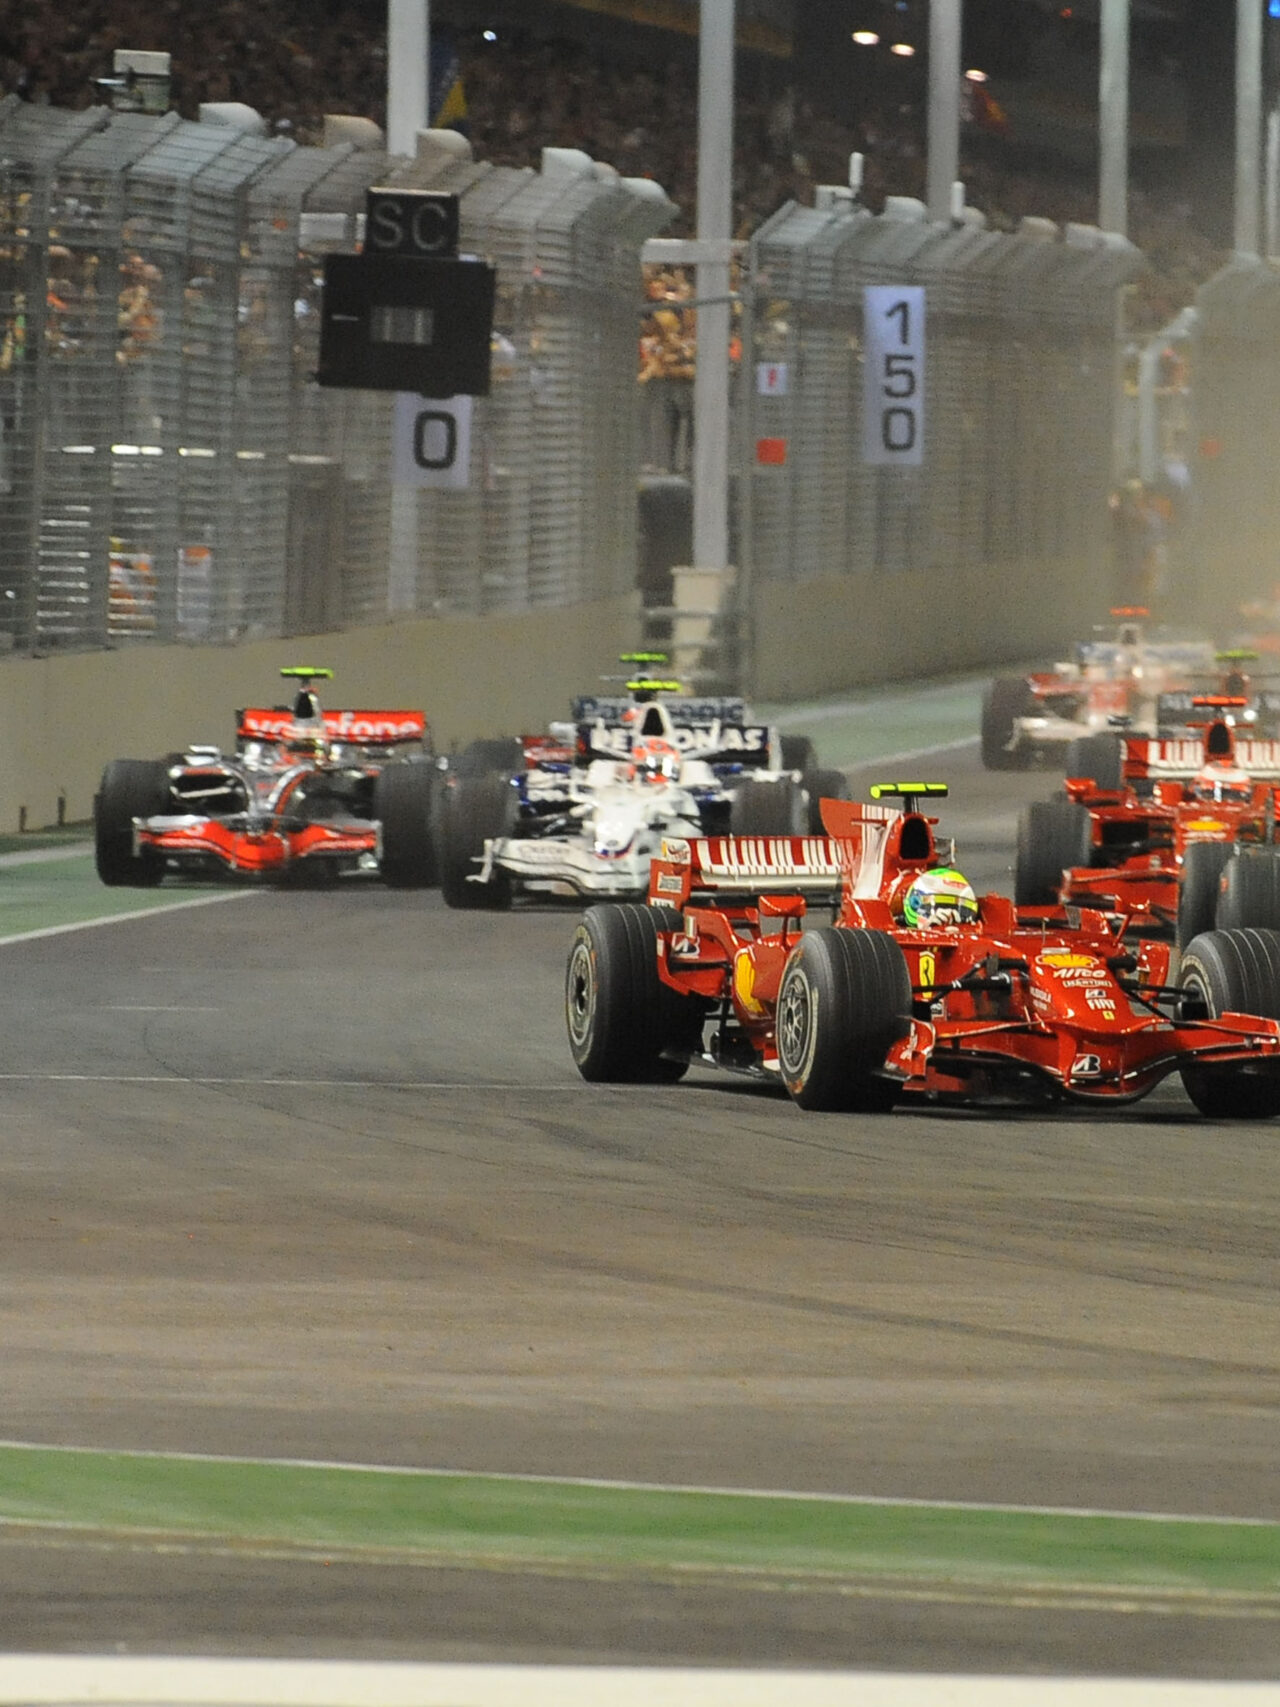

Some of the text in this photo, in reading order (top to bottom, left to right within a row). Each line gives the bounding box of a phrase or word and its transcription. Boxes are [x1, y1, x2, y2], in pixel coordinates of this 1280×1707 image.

[374, 201, 448, 250] SC
[578, 699, 743, 721] Pasonic
[245, 712, 421, 743] voafone
[591, 727, 764, 751] PEONAS
[1086, 999, 1117, 1011] FIAT
